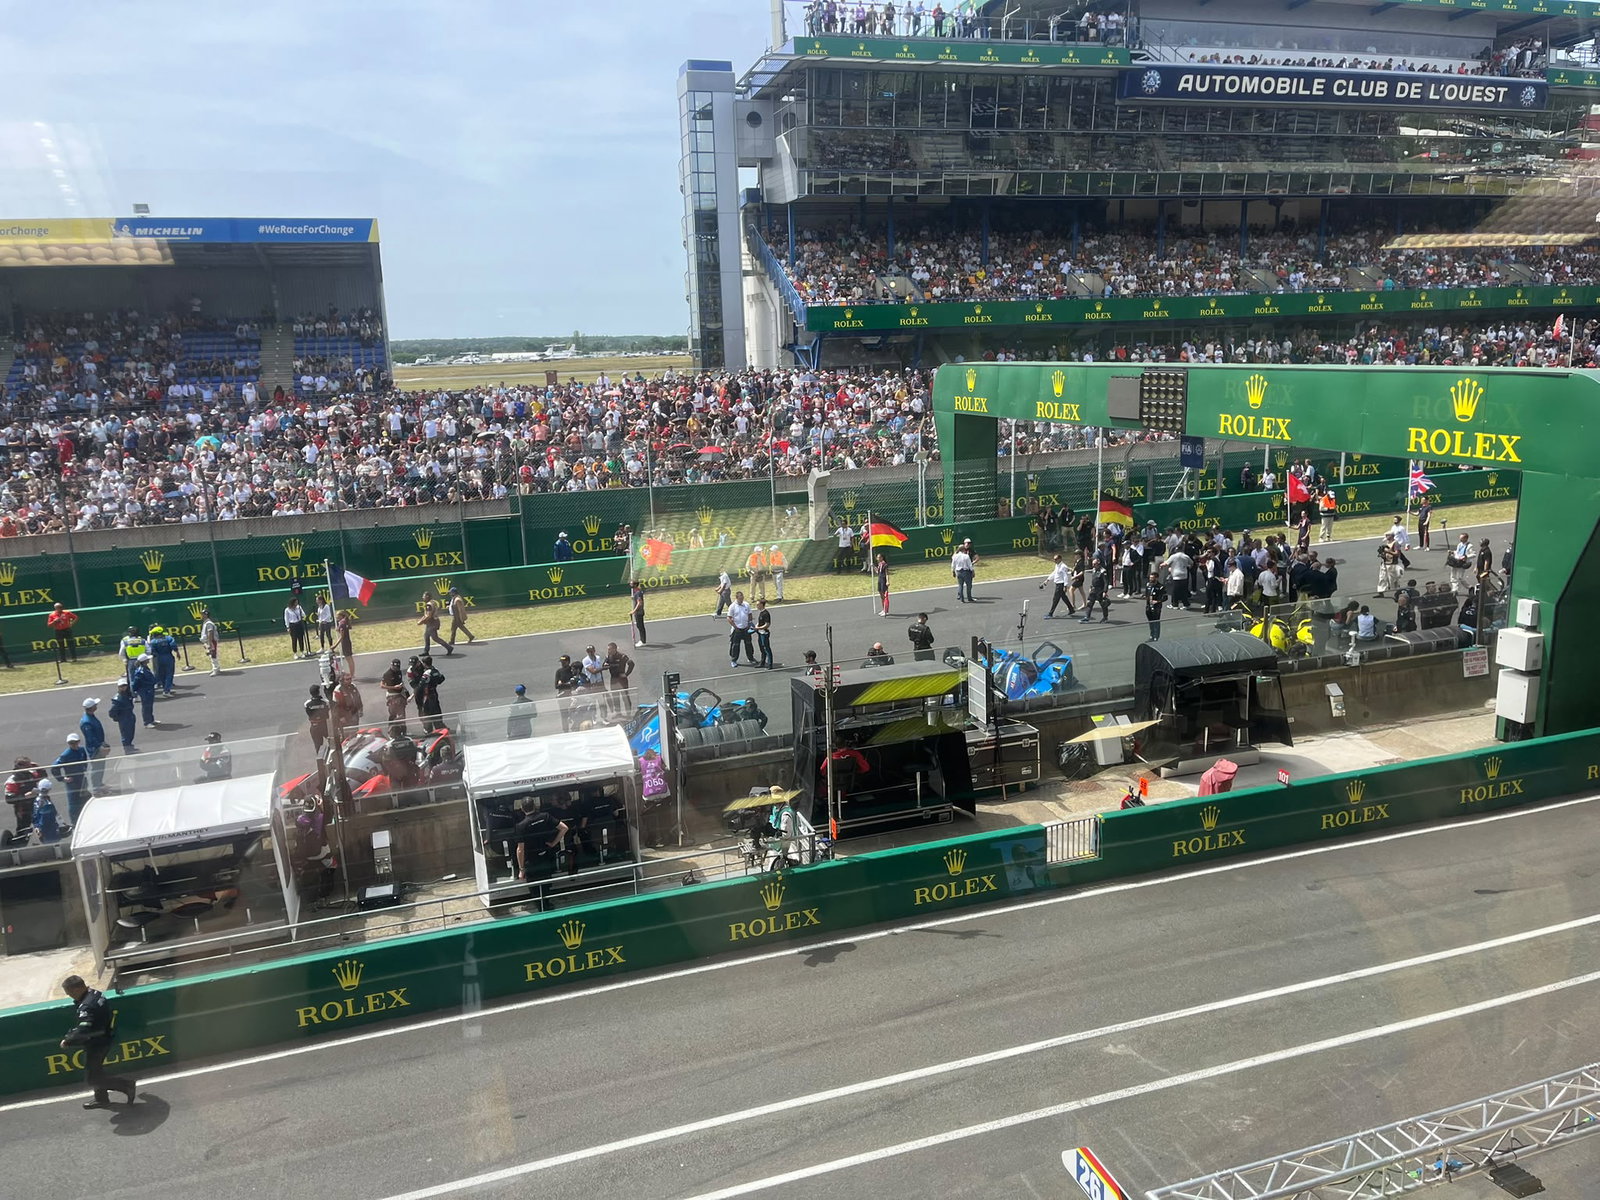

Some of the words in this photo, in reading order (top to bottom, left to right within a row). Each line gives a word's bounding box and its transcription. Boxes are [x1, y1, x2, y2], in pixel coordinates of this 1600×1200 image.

[1177, 74, 1326, 96] AUTOMOBILE
[1333, 79, 1388, 98] CLUB
[1395, 82, 1423, 99] DE
[1429, 83, 1508, 103] L'OUEST
[135, 227, 203, 236] MICHELIN
[258, 225, 355, 236] #WeRaceForChange
[1308, 304, 1332, 313] ROLEX
[1360, 302, 1384, 311] ROLEX
[1411, 300, 1433, 309] ROLEX
[1460, 298, 1482, 307] ROLEX
[1084, 311, 1112, 320] ROLEX
[1143, 309, 1169, 318] ROLEX
[1200, 308, 1225, 316] ROLEX
[1254, 306, 1279, 314] ROLEX
[833, 319, 864, 328] ROLEX
[899, 317, 929, 326] ROLEX
[964, 315, 993, 324] ROLEX
[1025, 313, 1052, 322] ROLEX
[954, 396, 988, 413] ROLEX
[1036, 401, 1080, 421] ROLEX
[1218, 413, 1292, 441] ROLEX
[1407, 427, 1522, 463] ROLEX
[1473, 486, 1511, 499] ROLEX
[1179, 517, 1221, 531] ROLEX
[389, 551, 464, 570] ROLEX
[113, 575, 200, 597] ROLEX
[528, 584, 586, 601] ROLEX
[1460, 779, 1524, 804] ROLEX
[1320, 803, 1390, 830] ROLEX
[167, 827, 209, 839] MANTHEY
[1172, 828, 1247, 858] ROLEX
[913, 873, 998, 906] ROLEX
[728, 907, 821, 942] ROLEX
[523, 945, 626, 982] ROLEX
[295, 987, 411, 1028] ROLEX
